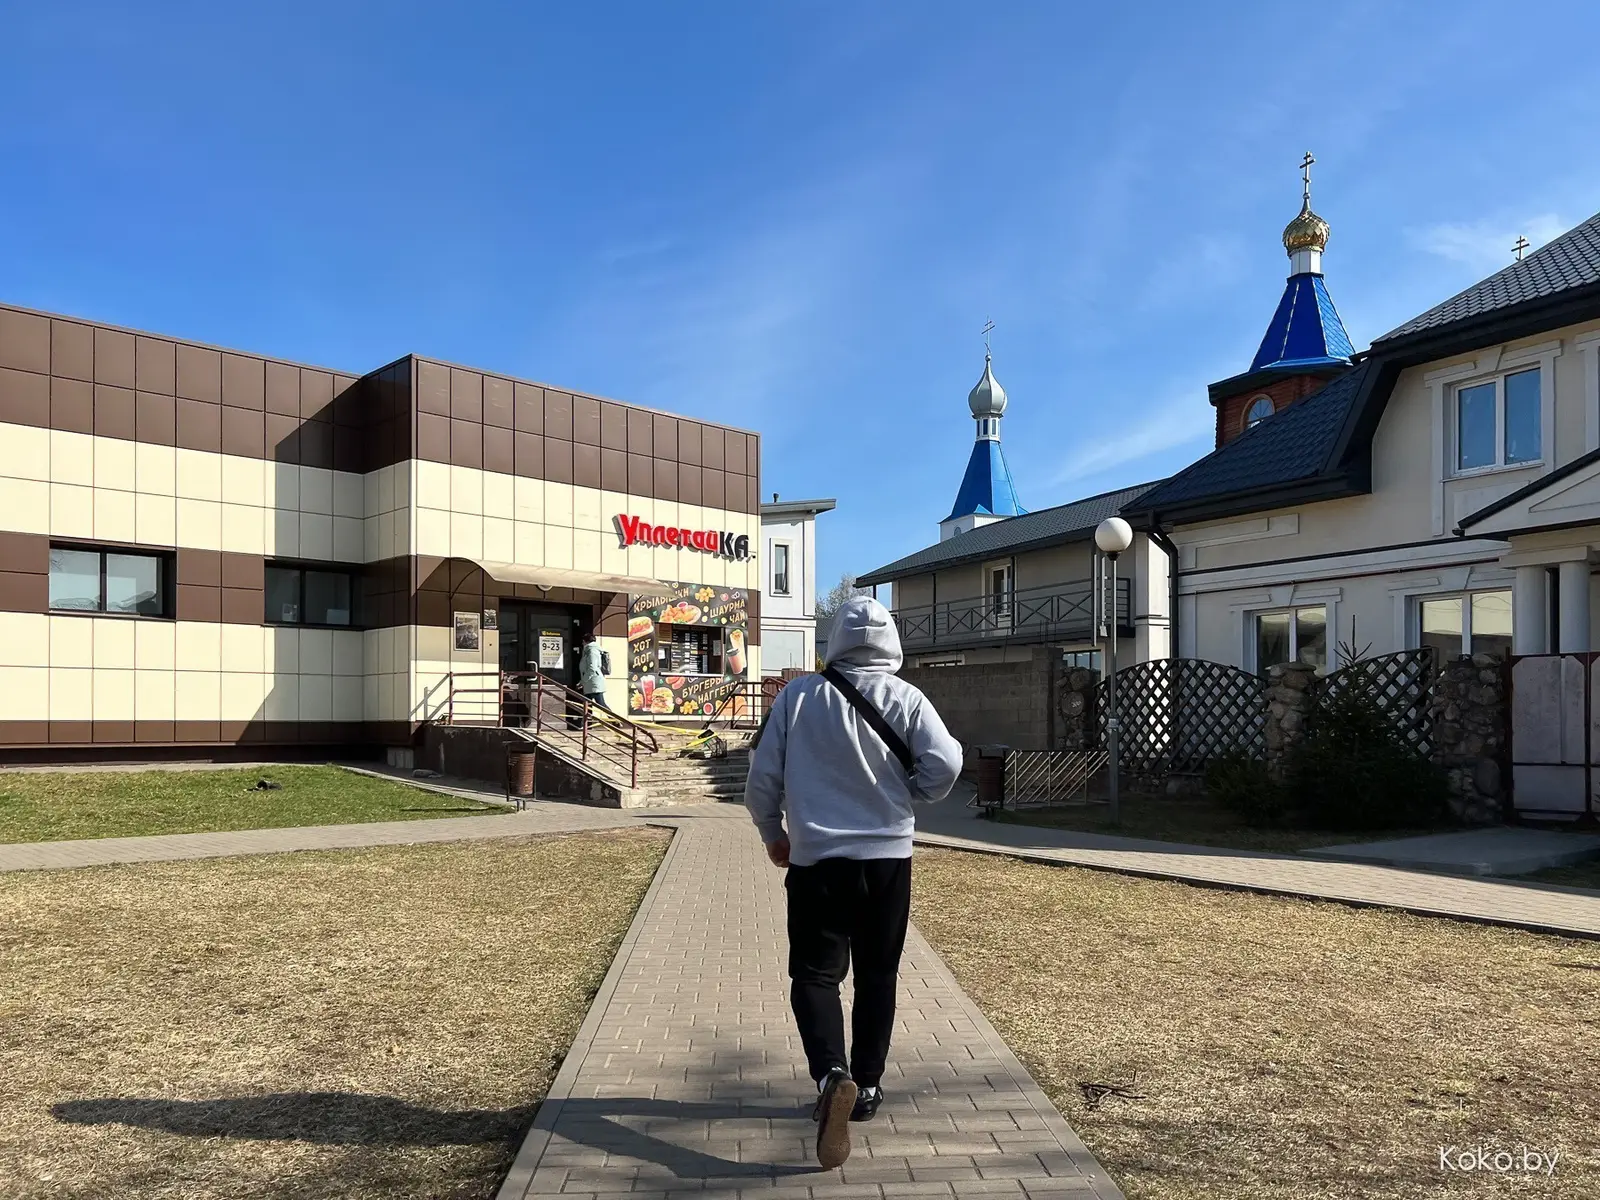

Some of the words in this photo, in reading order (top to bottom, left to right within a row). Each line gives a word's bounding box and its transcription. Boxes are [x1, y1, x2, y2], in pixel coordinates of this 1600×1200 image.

[541, 642, 560, 651] 9-23
[633, 638, 651, 653] ХОТ
[632, 651, 652, 668] ДОГ
[682, 676, 724, 698] БУРГЕРЫ
